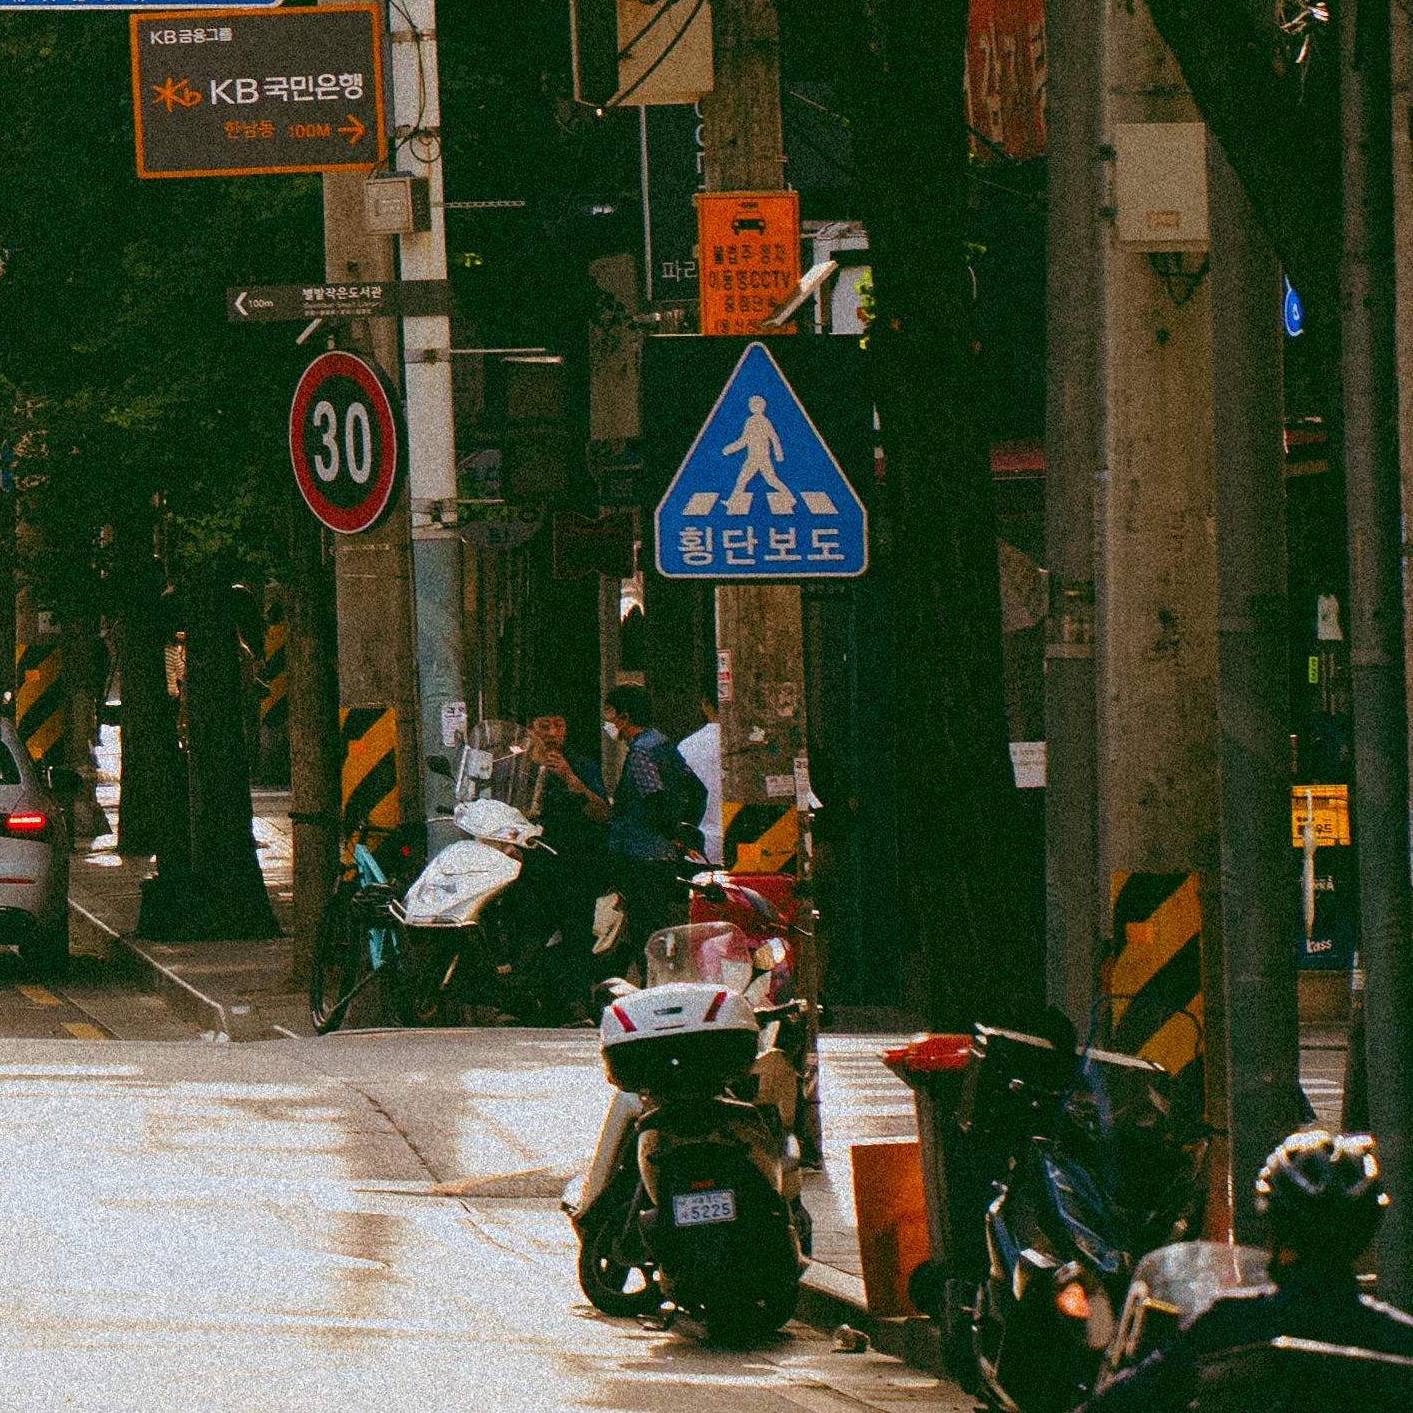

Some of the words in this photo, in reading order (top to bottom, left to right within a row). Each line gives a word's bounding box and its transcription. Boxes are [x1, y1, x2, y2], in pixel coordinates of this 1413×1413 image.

[209, 72, 364, 106] KB국민은행
[224, 119, 276, 141] 한남동
[312, 399, 372, 485] 30
[677, 527, 846, 568] 횡단보도
[691, 1202, 731, 1220] 5225
